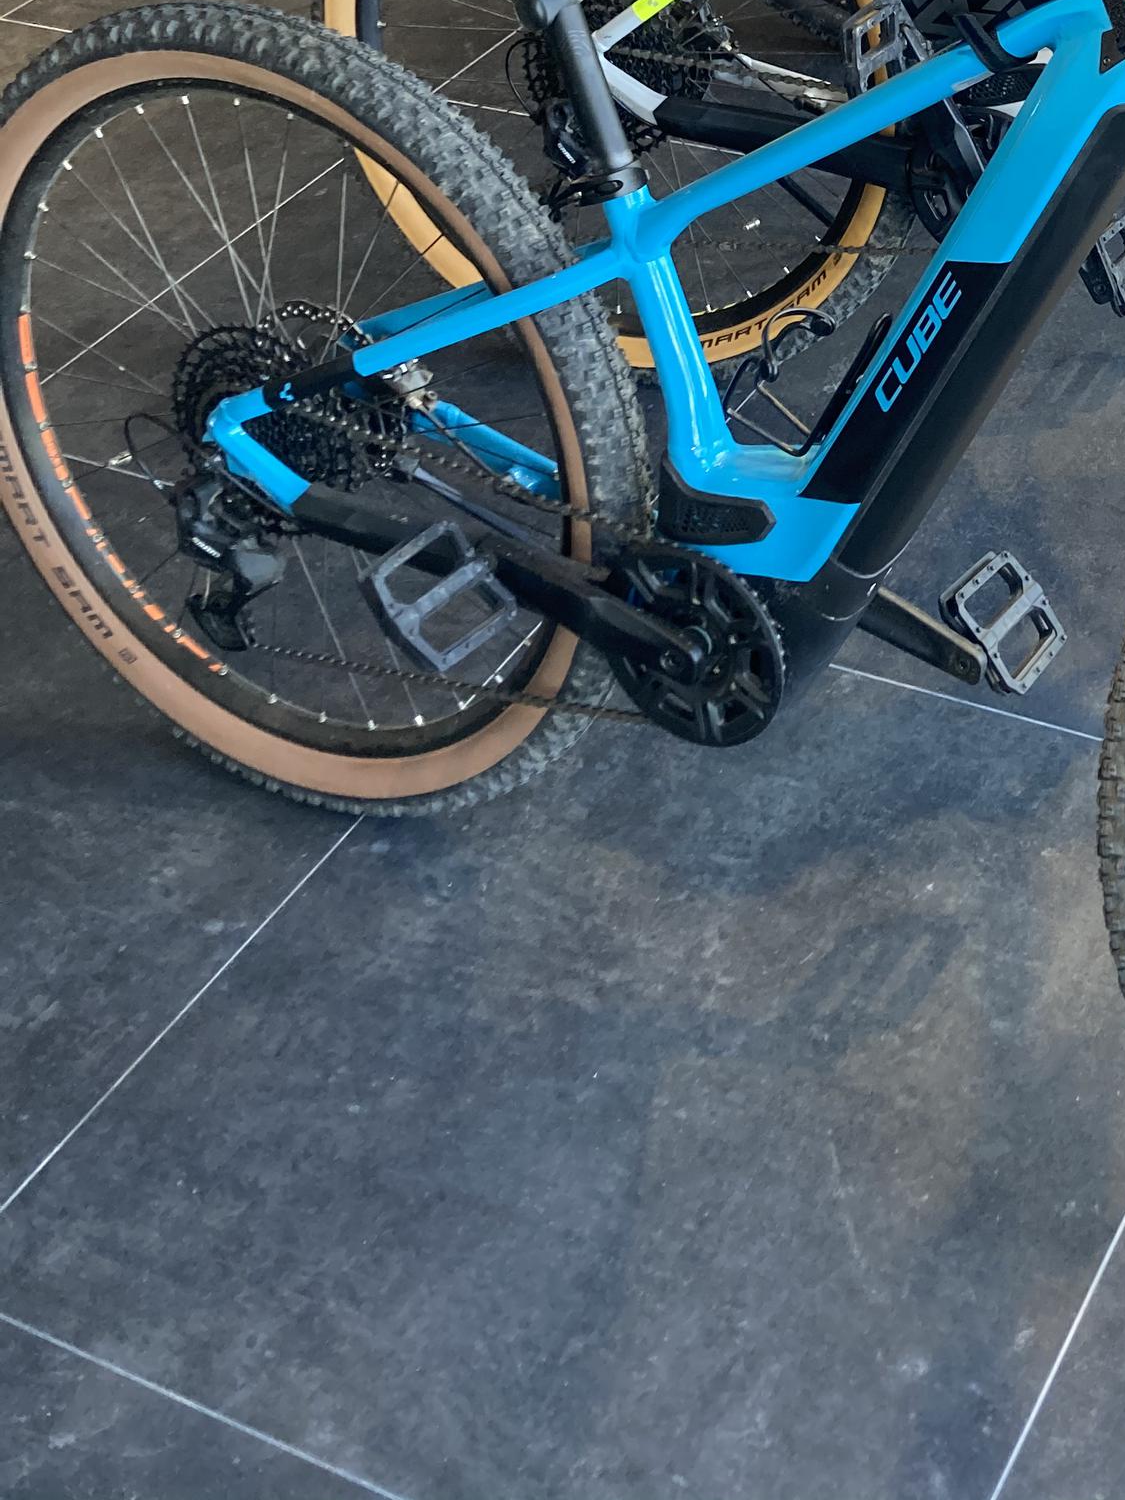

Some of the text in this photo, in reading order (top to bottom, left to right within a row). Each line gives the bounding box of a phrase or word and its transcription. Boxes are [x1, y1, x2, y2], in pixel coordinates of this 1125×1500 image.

[701, 317, 768, 349] MART
[874, 270, 963, 413] CUBE
[51, 565, 114, 640] SAM
